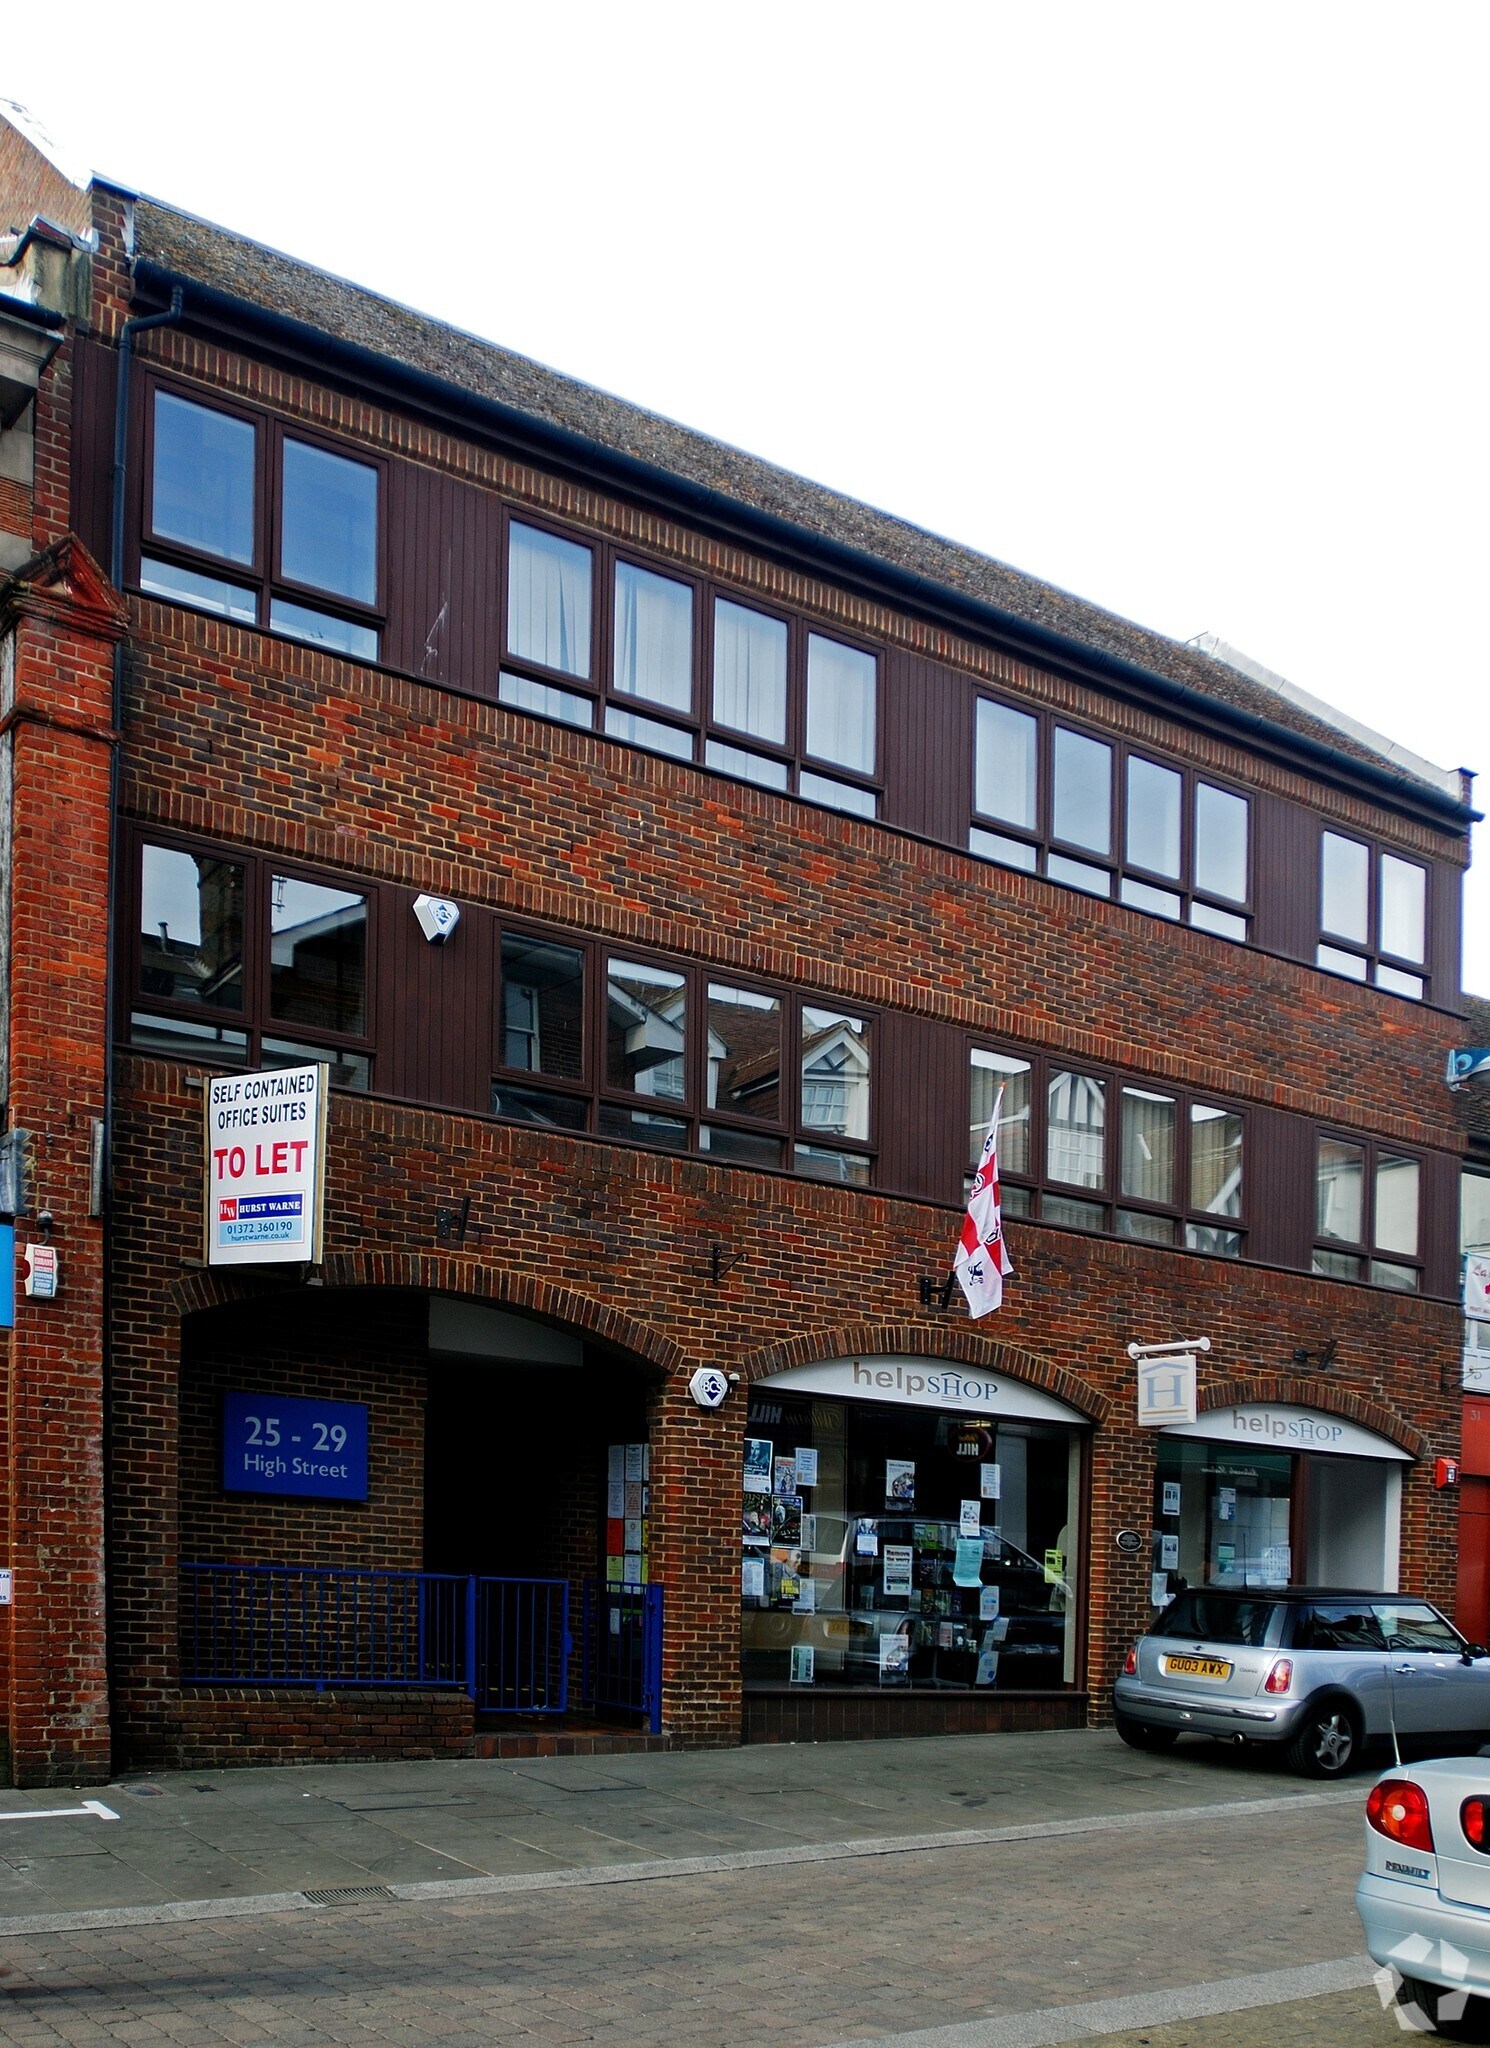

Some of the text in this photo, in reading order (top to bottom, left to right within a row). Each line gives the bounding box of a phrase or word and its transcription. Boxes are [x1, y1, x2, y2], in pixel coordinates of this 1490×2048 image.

[212, 1073, 315, 1104] SELF CONTAINED
[217, 1101, 306, 1129] OFFICE SUITES
[213, 1140, 309, 1179] TO LET
[239, 1201, 301, 1213] HURST WARNE
[227, 1221, 293, 1234] 01372 360190
[231, 1232, 289, 1242] hurstwarne.co.uk
[852, 1361, 999, 1401] helpSHOP
[244, 1416, 281, 1447] 25
[312, 1423, 347, 1453] 29
[1232, 1409, 1343, 1442] helpSHOP
[244, 1453, 348, 1478] High Street
[1170, 1658, 1225, 1675] GU03 AWX
[1385, 1860, 1431, 1880] RENAULT
